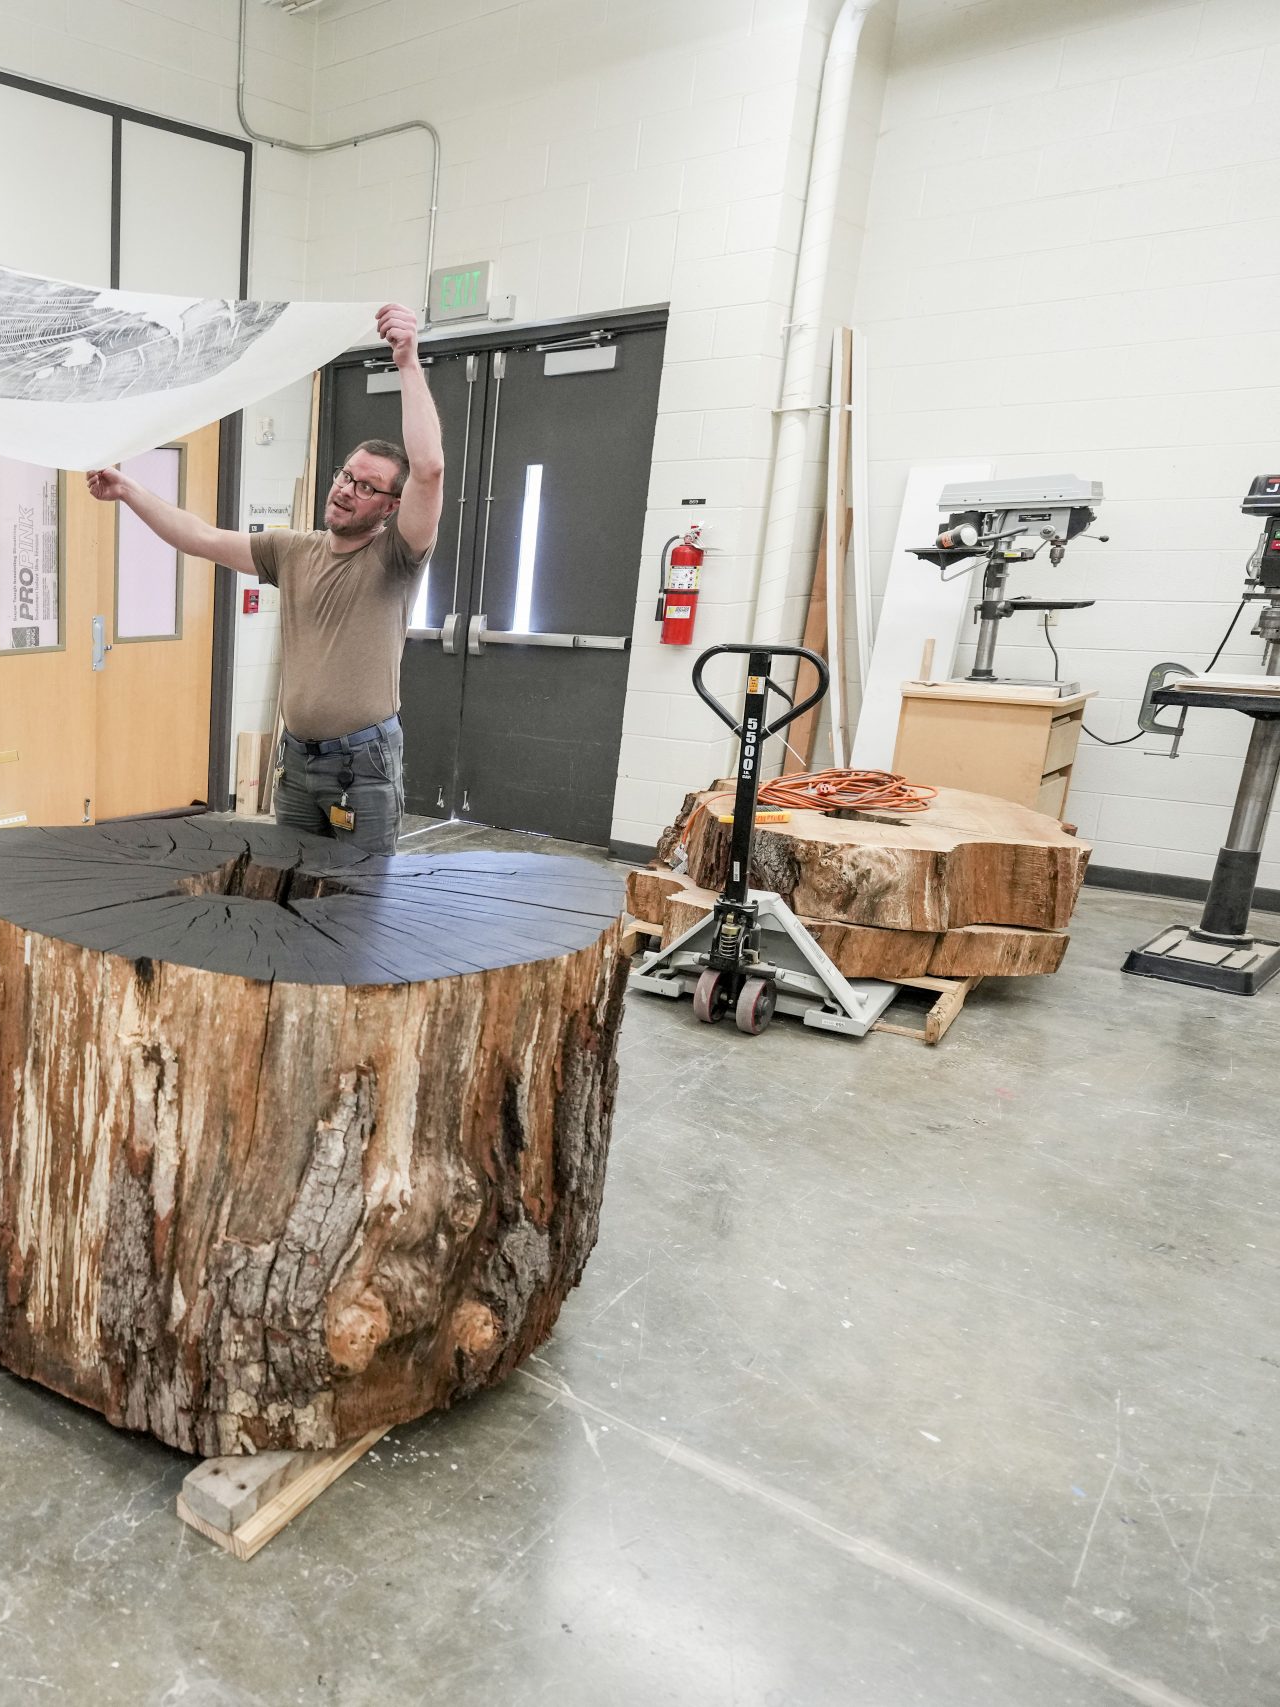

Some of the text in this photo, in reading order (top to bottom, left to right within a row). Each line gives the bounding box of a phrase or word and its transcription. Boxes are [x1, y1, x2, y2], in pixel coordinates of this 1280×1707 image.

[441, 270, 481, 311] EXIT
[251, 506, 289, 515] Faculty Research
[18, 504, 34, 621] PROPINK
[742, 717, 758, 771] 5500
